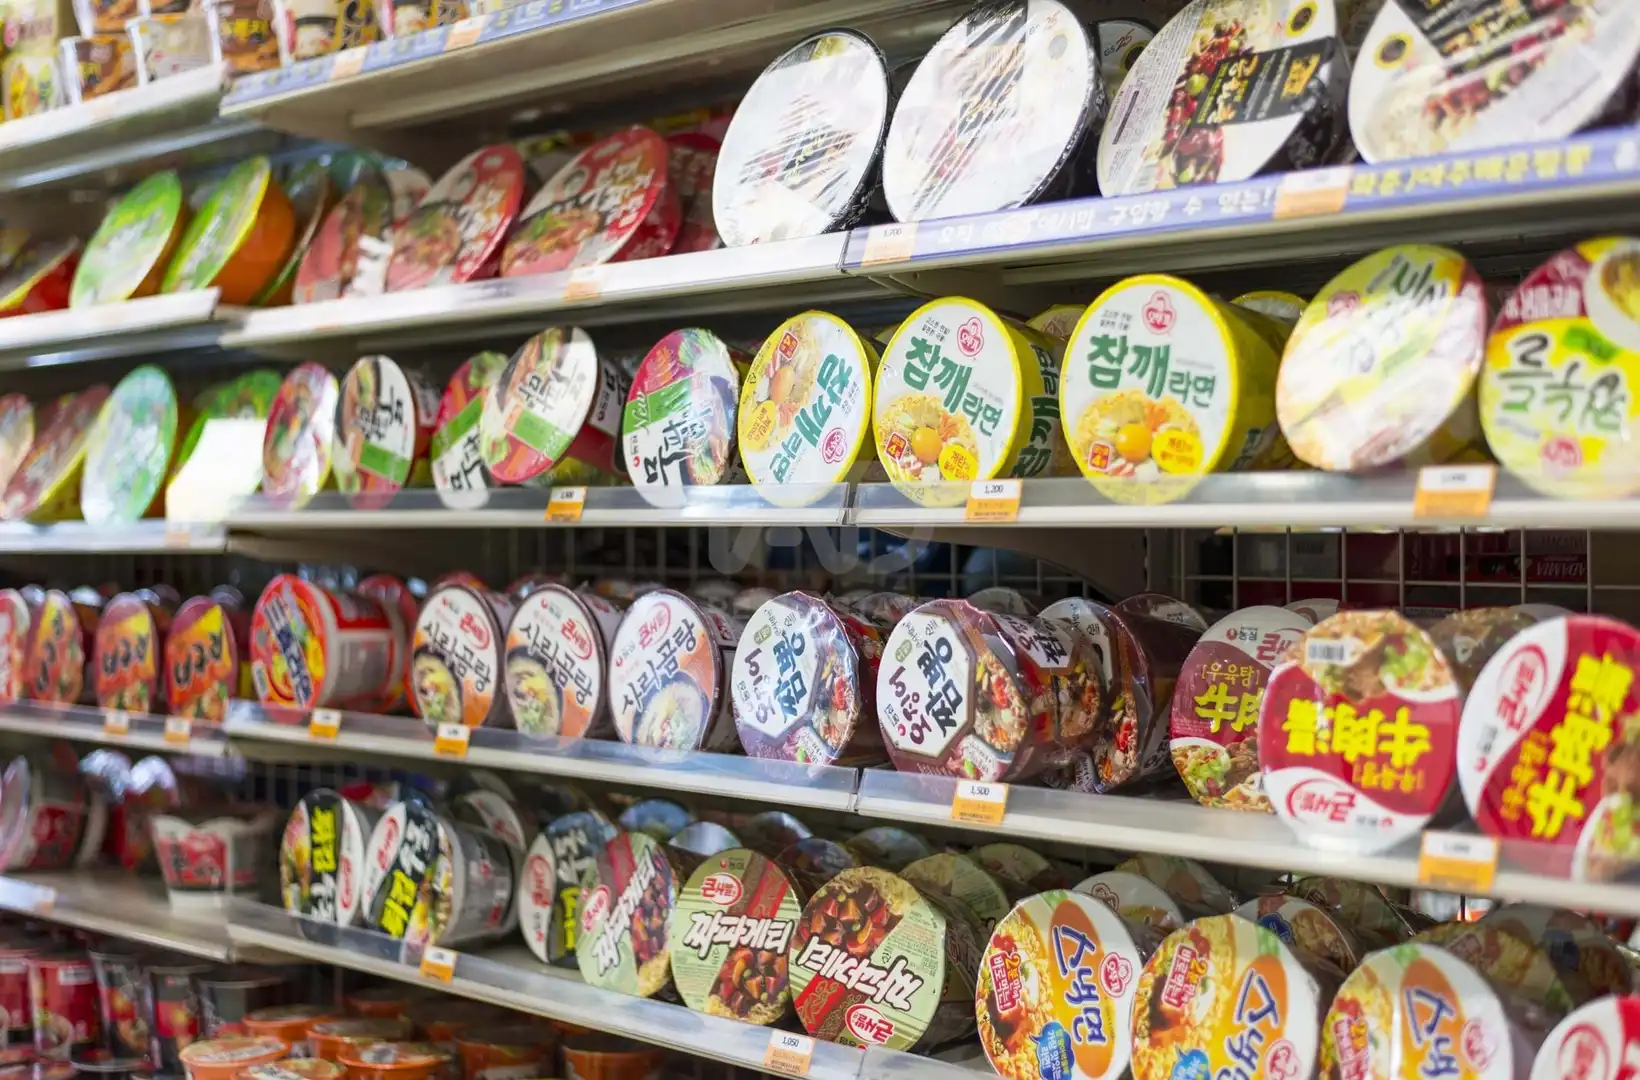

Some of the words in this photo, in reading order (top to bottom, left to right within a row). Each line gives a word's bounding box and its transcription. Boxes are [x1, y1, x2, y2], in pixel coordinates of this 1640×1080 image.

[1183, 194, 1204, 216] 수
[903, 336, 1004, 437] 참깨라면
[1087, 333, 1216, 408] 참깨라면
[769, 352, 853, 484] 참깨라면
[424, 621, 491, 692] 사리곰탕
[519, 621, 593, 706] 사리곰탕
[621, 617, 697, 715] 사리곰탕
[1239, 627, 1258, 641] 농심
[773, 631, 807, 724] 짬뽕
[888, 666, 932, 745] 오징어
[916, 636, 963, 738] 짬뽕
[971, 786, 990, 796] 1,500
[592, 845, 657, 977] 짜파게티
[683, 910, 795, 959] 짜파게티
[795, 933, 924, 1011] 짜파게티
[992, 956, 1013, 1010] 바로먹는!
[1052, 924, 1107, 1044] 스낵면
[1106, 959, 1124, 994] 오뚜기
[1164, 947, 1194, 1007] 바로먹는!
[782, 1036, 800, 1047] 1,050
[1406, 988, 1460, 1077] 스낵
